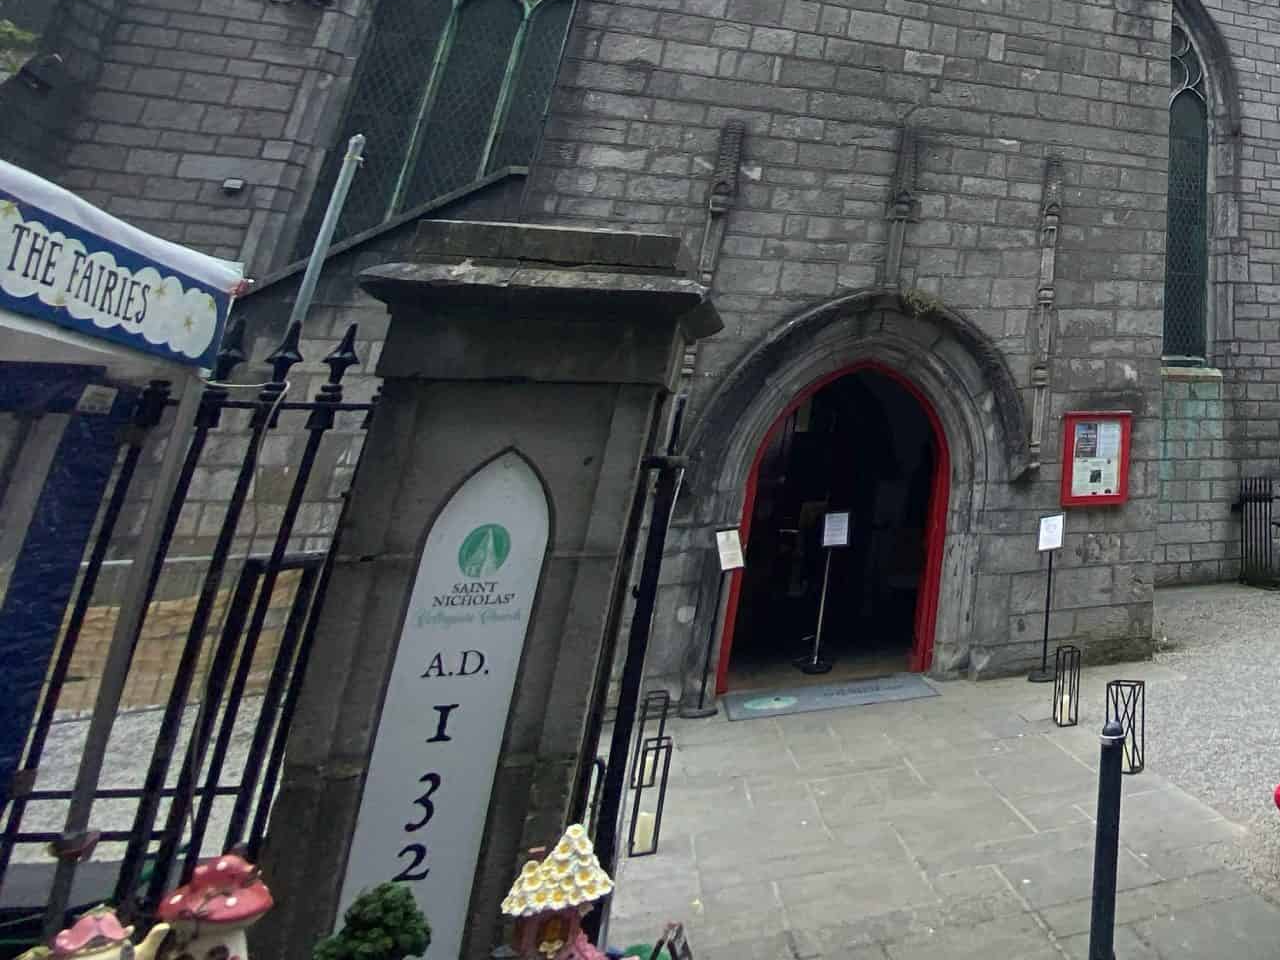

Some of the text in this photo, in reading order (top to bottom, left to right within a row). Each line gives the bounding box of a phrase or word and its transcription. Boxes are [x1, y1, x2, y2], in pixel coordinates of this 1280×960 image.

[7, 223, 151, 324] THE FAIRIES
[452, 581, 498, 594] SAINT
[420, 649, 490, 678] A.D.
